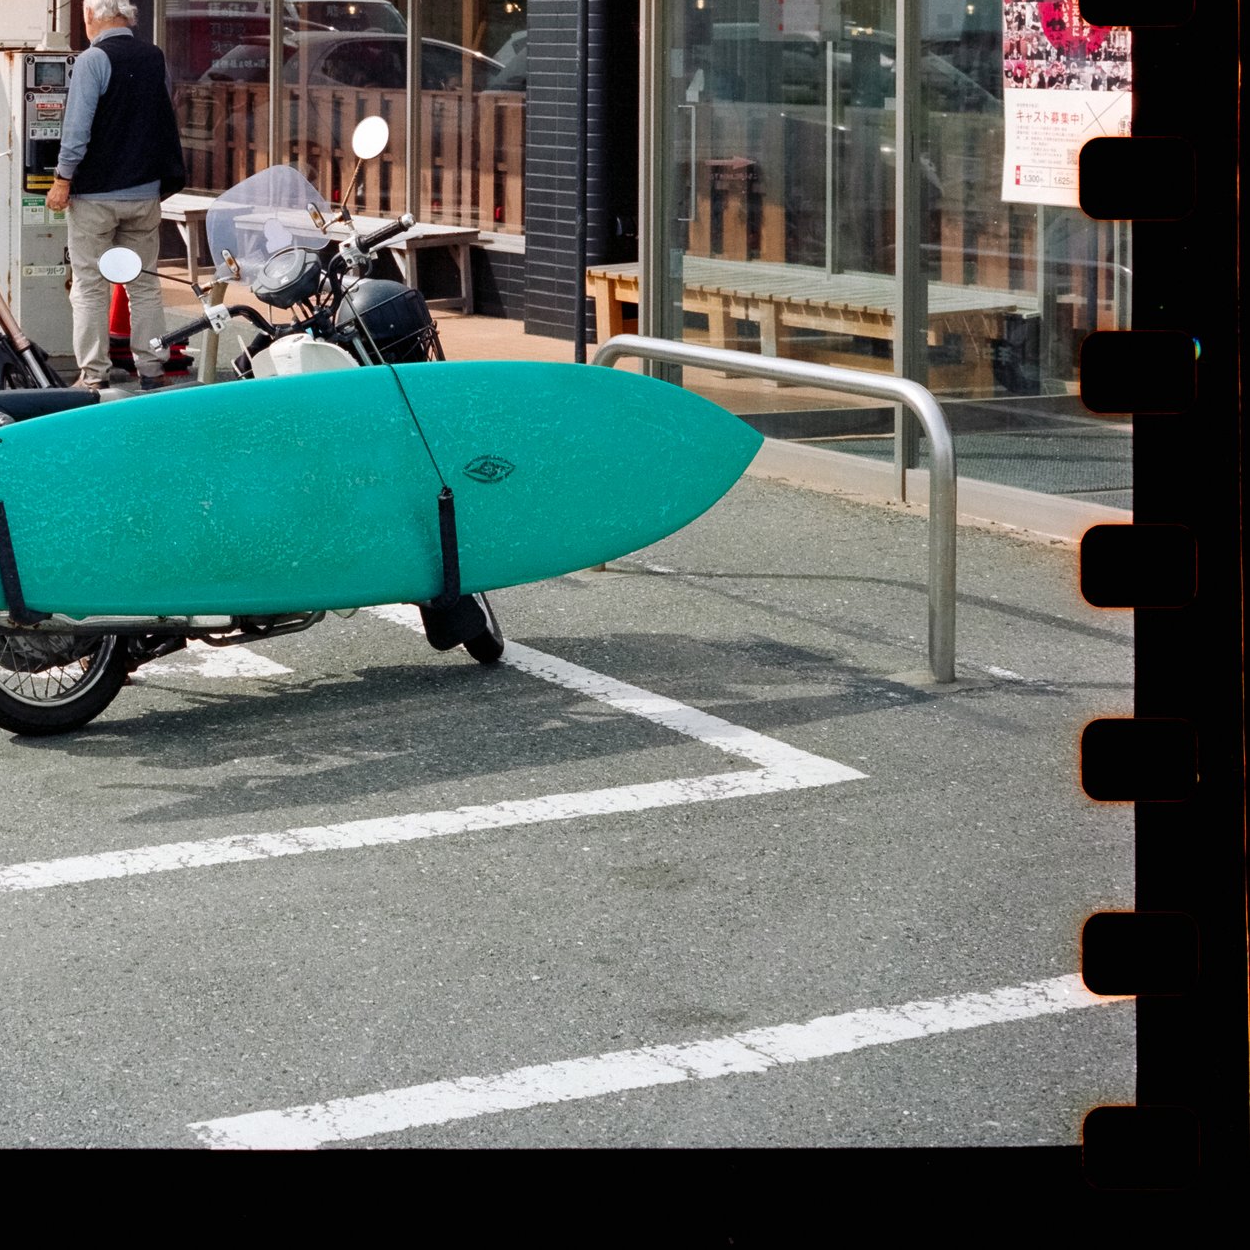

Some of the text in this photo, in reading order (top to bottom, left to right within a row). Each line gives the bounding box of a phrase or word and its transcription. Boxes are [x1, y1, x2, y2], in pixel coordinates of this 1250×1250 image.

[1016, 109, 1084, 126] キャスト募集中!
